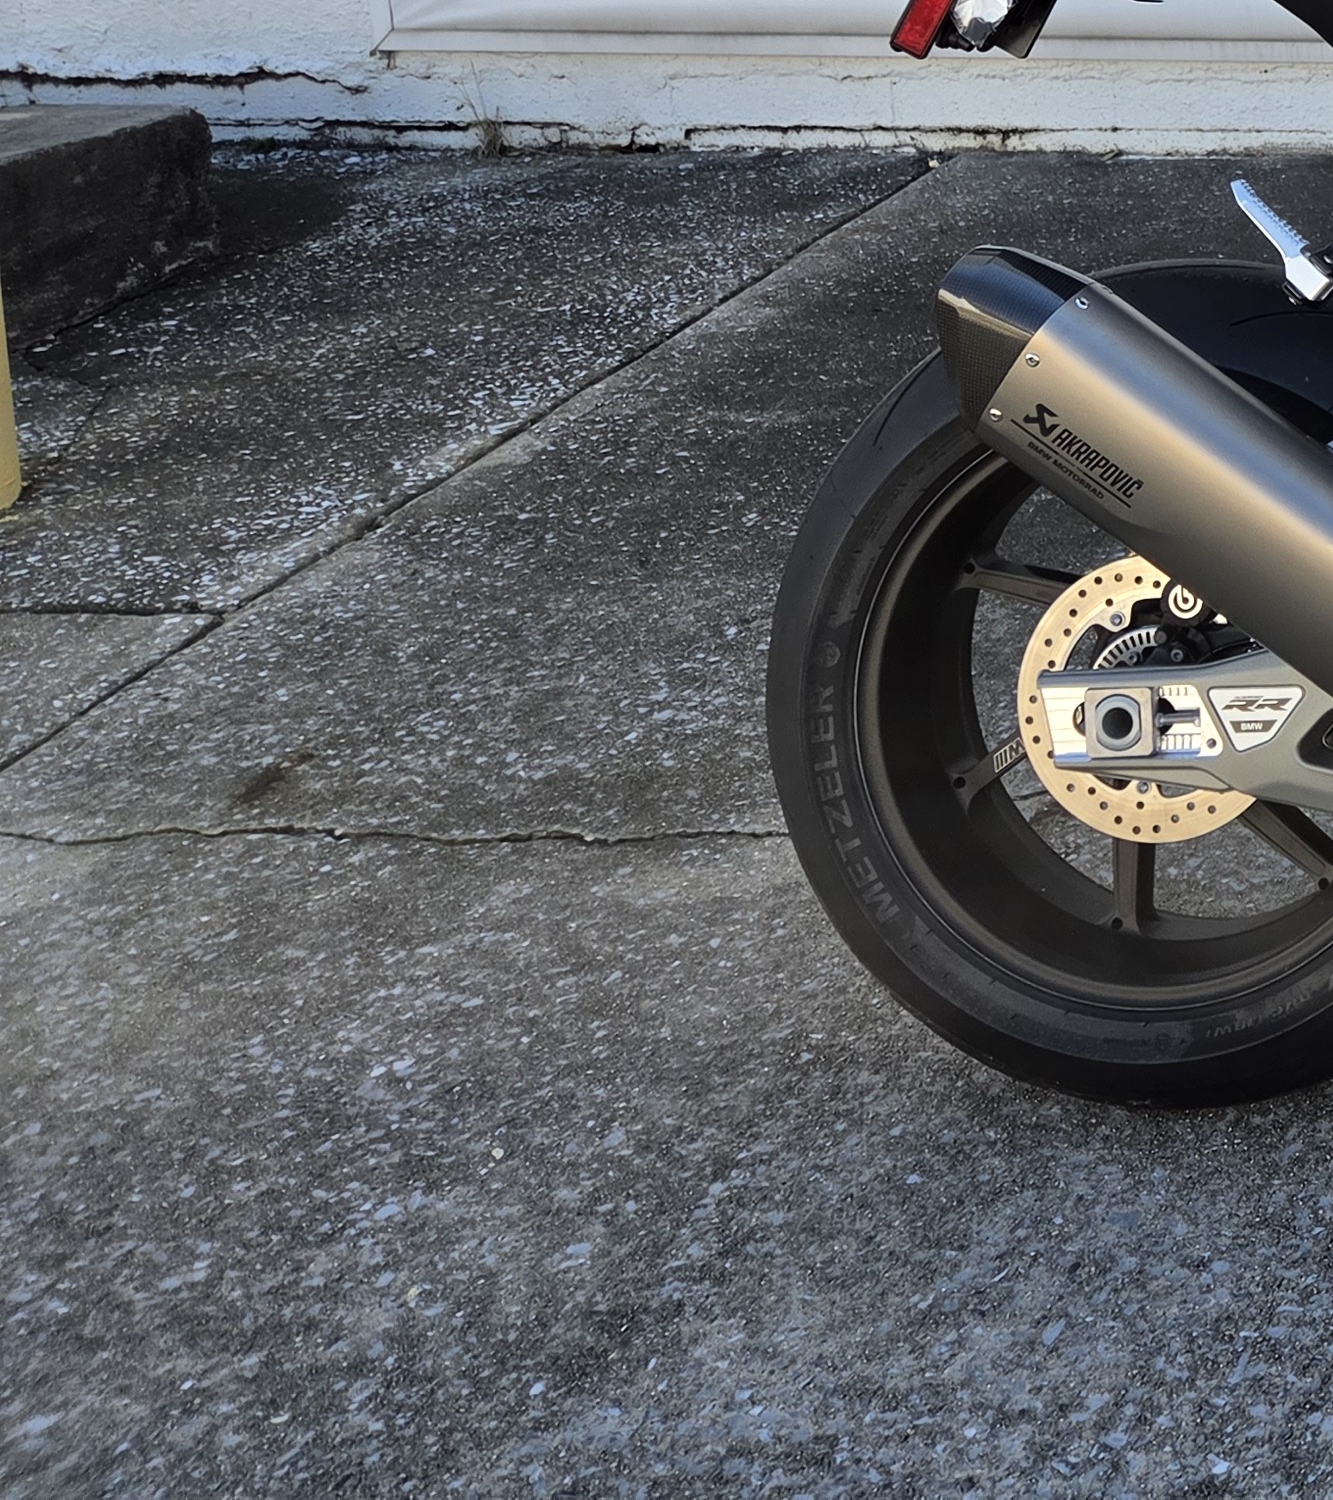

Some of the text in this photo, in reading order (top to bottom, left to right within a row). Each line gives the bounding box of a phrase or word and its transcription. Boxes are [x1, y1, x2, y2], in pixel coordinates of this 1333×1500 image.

[1027, 440, 1105, 500] BMW MOTORRAD
[1221, 697, 1293, 713] RR
[1240, 722, 1264, 731] BMW
[809, 692, 901, 929] METZELER
